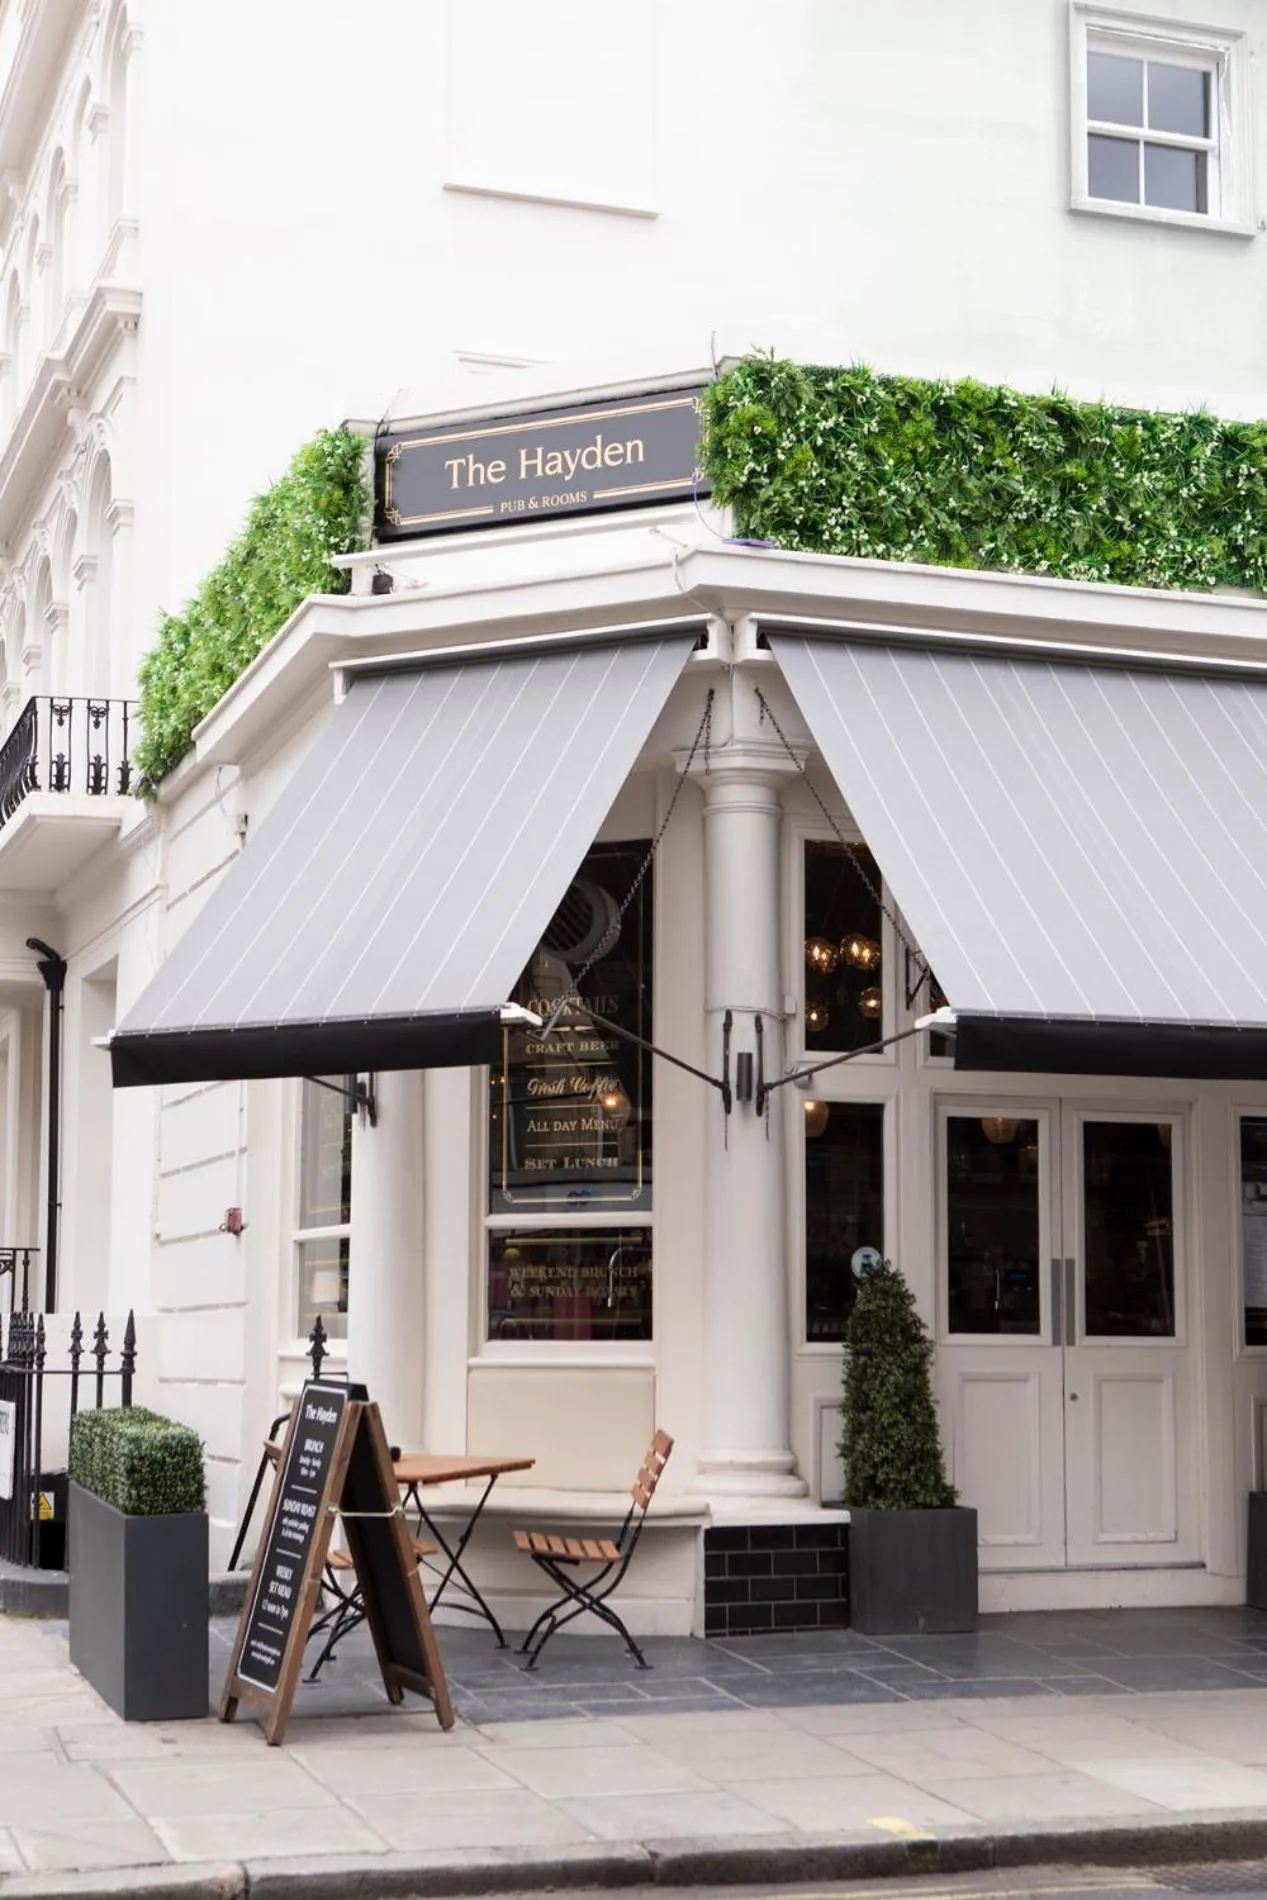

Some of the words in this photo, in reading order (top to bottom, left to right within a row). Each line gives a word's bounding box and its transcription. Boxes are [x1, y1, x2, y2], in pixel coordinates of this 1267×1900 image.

[445, 454, 507, 490] The
[519, 434, 646, 481] Hayden
[500, 498, 526, 514] PUB
[528, 496, 540, 510] &
[541, 490, 588, 508] ROOMS
[525, 1041, 575, 1054] CRAFT
[579, 1040, 620, 1052] BEER
